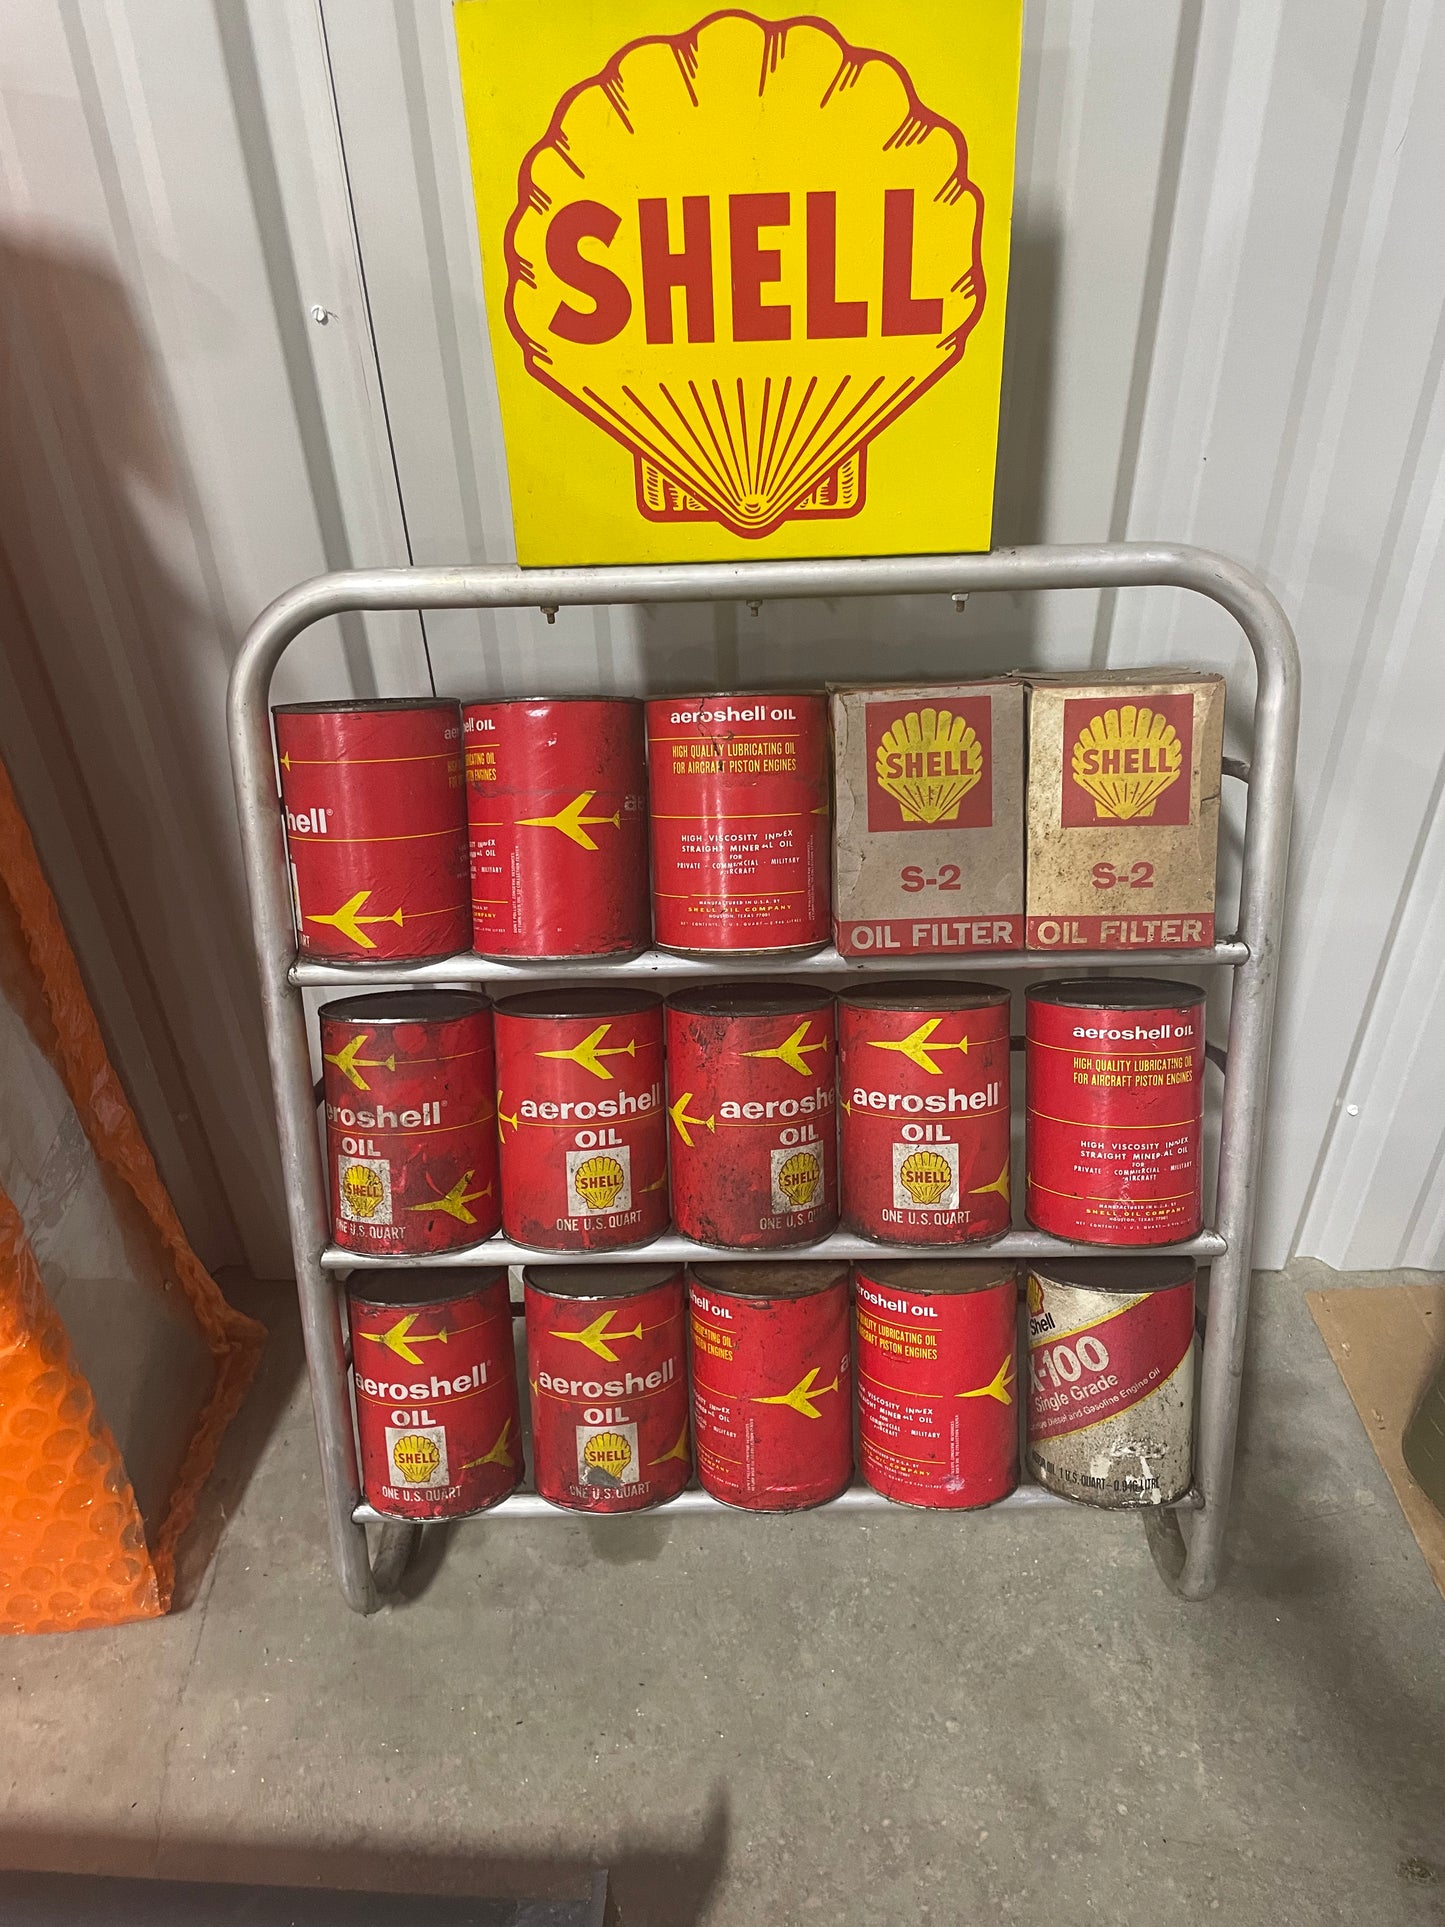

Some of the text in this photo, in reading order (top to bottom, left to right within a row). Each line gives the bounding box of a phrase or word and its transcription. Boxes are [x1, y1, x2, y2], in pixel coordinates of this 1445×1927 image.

[545, 189, 943, 345] SHELL
[670, 706, 797, 724] aeroshell OIL
[476, 719, 496, 732] OIL
[672, 745, 688, 758] HIGH
[728, 741, 782, 756] LUBRICATING
[785, 741, 796, 754] OIL
[673, 762, 685, 774] FOR
[729, 760, 760, 773] PISTON
[763, 758, 796, 771] ENGINES
[886, 750, 974, 779] SHELL
[1083, 748, 1173, 775] SHELL
[708, 833, 758, 842] VISCOSITY
[681, 845, 724, 853] STRAIGHT
[779, 840, 793, 848] OIL
[770, 857, 800, 865] MILITARY
[900, 864, 961, 892] S-2
[1092, 862, 1154, 889] S-2
[744, 904, 792, 912] COMPANY
[851, 921, 1013, 950] OIL FILTER
[1037, 919, 1203, 945] OIL FILTER
[1073, 1025, 1194, 1040] aeroshell OIL
[1073, 1055, 1193, 1073] HIGH QUALITY LUBRICATING OIL
[1073, 1070, 1193, 1087] FOR AIRCRAFT PISTON ENGINES
[520, 1082, 660, 1120] aeroshell
[853, 1082, 999, 1113] aeroshell
[575, 1128, 622, 1148] OIL
[780, 1124, 818, 1145] OIL
[901, 1123, 951, 1142] OIL
[342, 1137, 381, 1156] OIL
[1080, 1140, 1105, 1149] HIGH
[1111, 1143, 1160, 1151] VISCOSITY
[1080, 1150, 1126, 1160] STRAIGHT
[1177, 1146, 1188, 1155] OIL
[1073, 1165, 1101, 1175] PRIVATE
[1170, 1161, 1193, 1172] MILITARY
[580, 1174, 619, 1189] SHELL
[784, 1171, 817, 1186] SHELL
[906, 1171, 947, 1183] SHELL
[347, 1183, 379, 1198] SHELL
[882, 1208, 971, 1225] ONE U.S. QUART
[1086, 1208, 1117, 1216] SHELL
[1145, 1206, 1185, 1216] COMPANY
[557, 1210, 642, 1231] ONE U.S. QUART
[760, 1216, 782, 1230] ONE
[369, 1226, 406, 1239] QUART
[711, 1305, 733, 1320] OIL
[911, 1305, 938, 1317] OIL
[1030, 1312, 1056, 1336] Shell
[722, 1335, 733, 1348] OIL
[878, 1323, 922, 1345] LUBRICATING
[925, 1334, 938, 1346] OIL
[707, 1342, 733, 1361] ENGINES
[879, 1337, 938, 1360] PISTON ENGINES
[355, 1362, 487, 1400] aeroshell
[539, 1358, 674, 1398] aeroshell
[1035, 1373, 1119, 1413] Single Grade
[1083, 1395, 1120, 1415] Gasoline
[1119, 1378, 1149, 1399] Engine
[1148, 1367, 1161, 1381] Oil
[867, 1391, 900, 1410] VISCOSITY
[391, 1410, 437, 1427] OIL
[583, 1407, 630, 1424] OIL
[718, 1414, 730, 1423] OIL
[918, 1416, 933, 1424] OIL
[911, 1429, 941, 1439] MILITARY
[398, 1453, 436, 1464] SHELL
[589, 1450, 627, 1462] SHELL
[889, 1462, 930, 1476] COMPANY
[1081, 1474, 1105, 1490] QUART
[382, 1485, 462, 1502] ONE U.S. QUART
